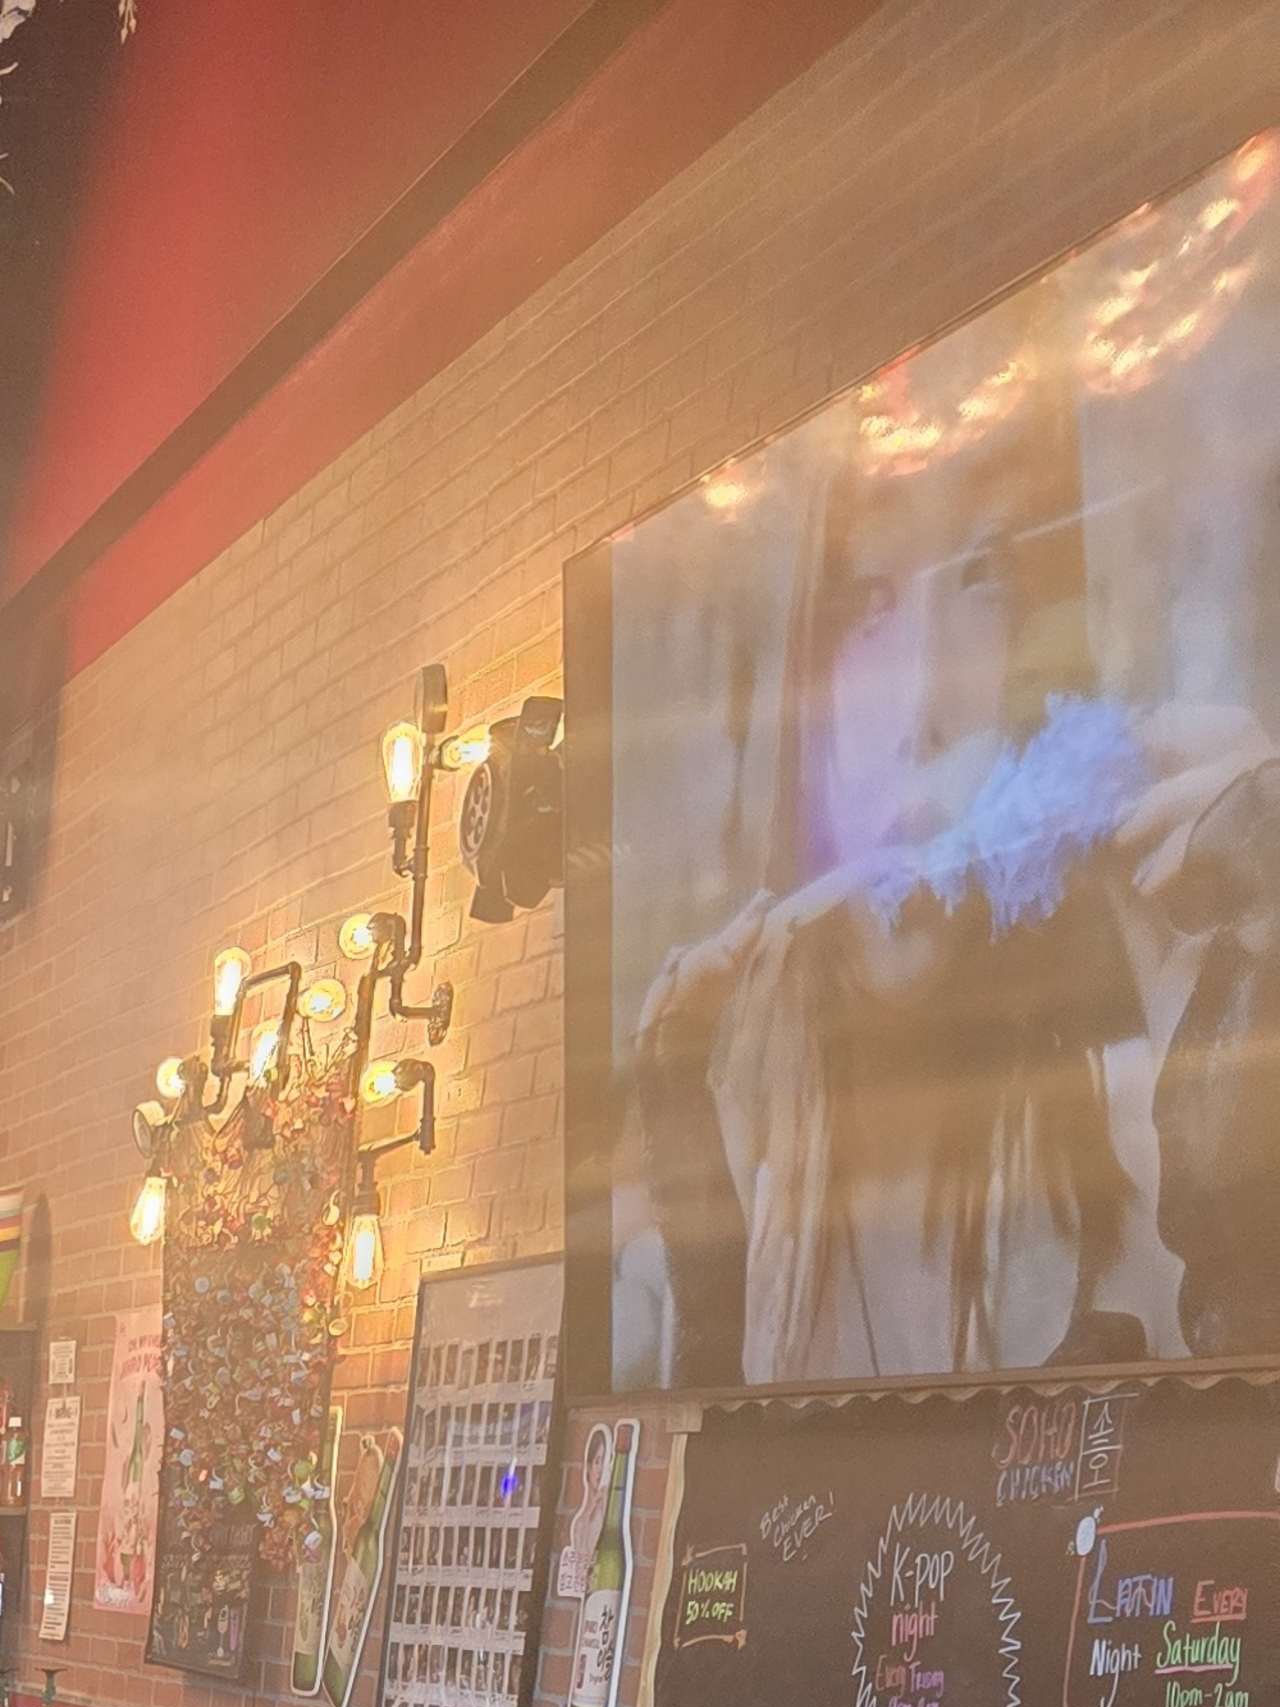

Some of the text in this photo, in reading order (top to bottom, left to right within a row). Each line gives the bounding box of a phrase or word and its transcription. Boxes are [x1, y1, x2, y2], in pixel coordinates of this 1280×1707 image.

[993, 1401, 1077, 1467] SOHO
[687, 1567, 739, 1595] HOOKAH
[711, 1600, 735, 1623] OFF
[891, 1601, 941, 1662] night
[1155, 1619, 1242, 1687] Saturday
